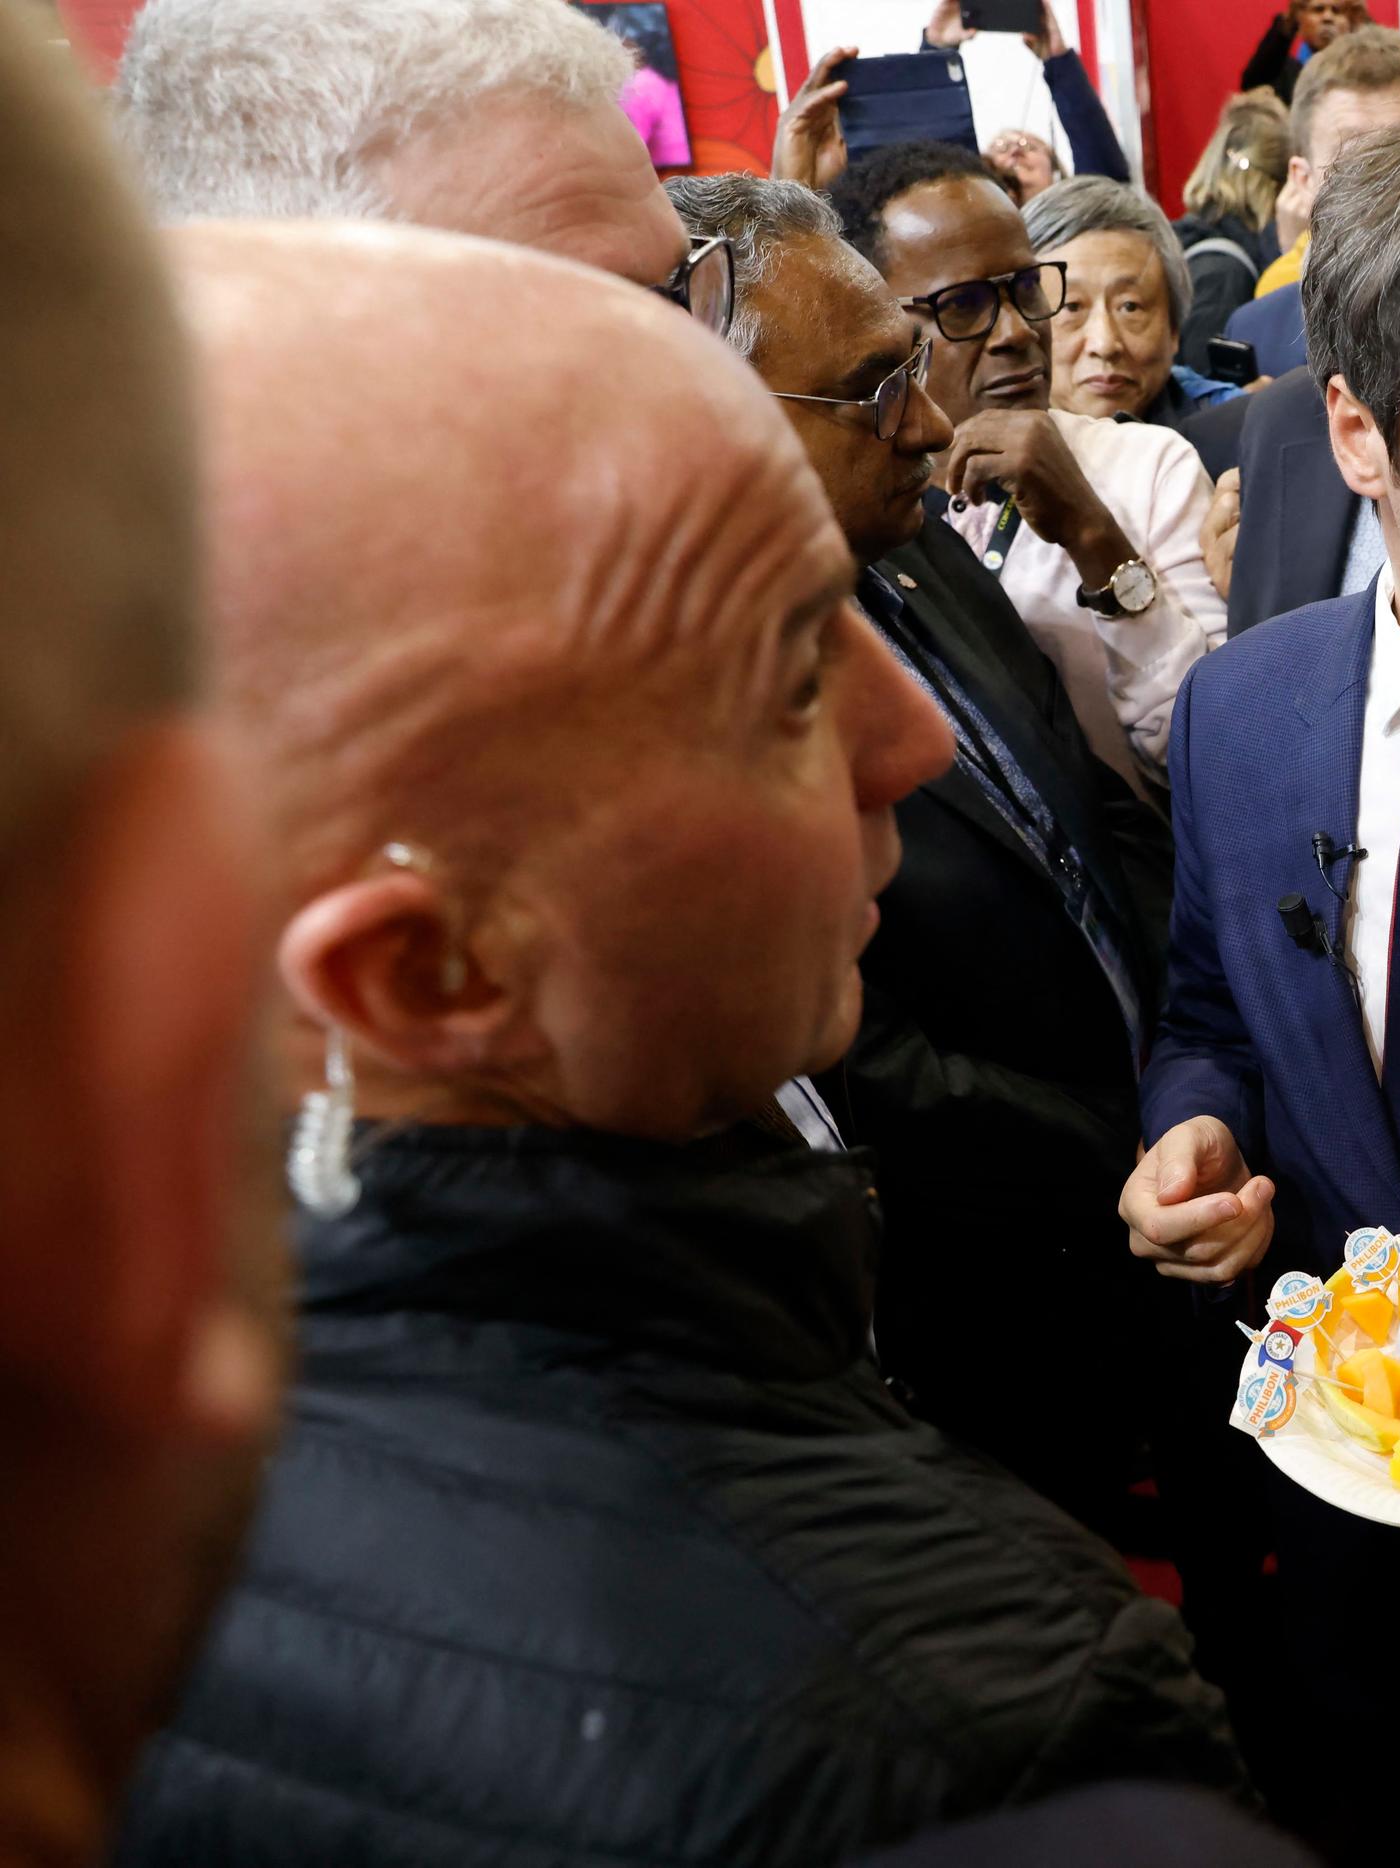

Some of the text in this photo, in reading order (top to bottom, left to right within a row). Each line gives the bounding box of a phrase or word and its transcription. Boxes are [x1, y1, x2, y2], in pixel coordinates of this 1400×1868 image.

[1350, 1234, 1388, 1270] PHILIBON
[1275, 1285, 1320, 1310] PHILIBON
[1249, 1372, 1279, 1425] PHILIBON
